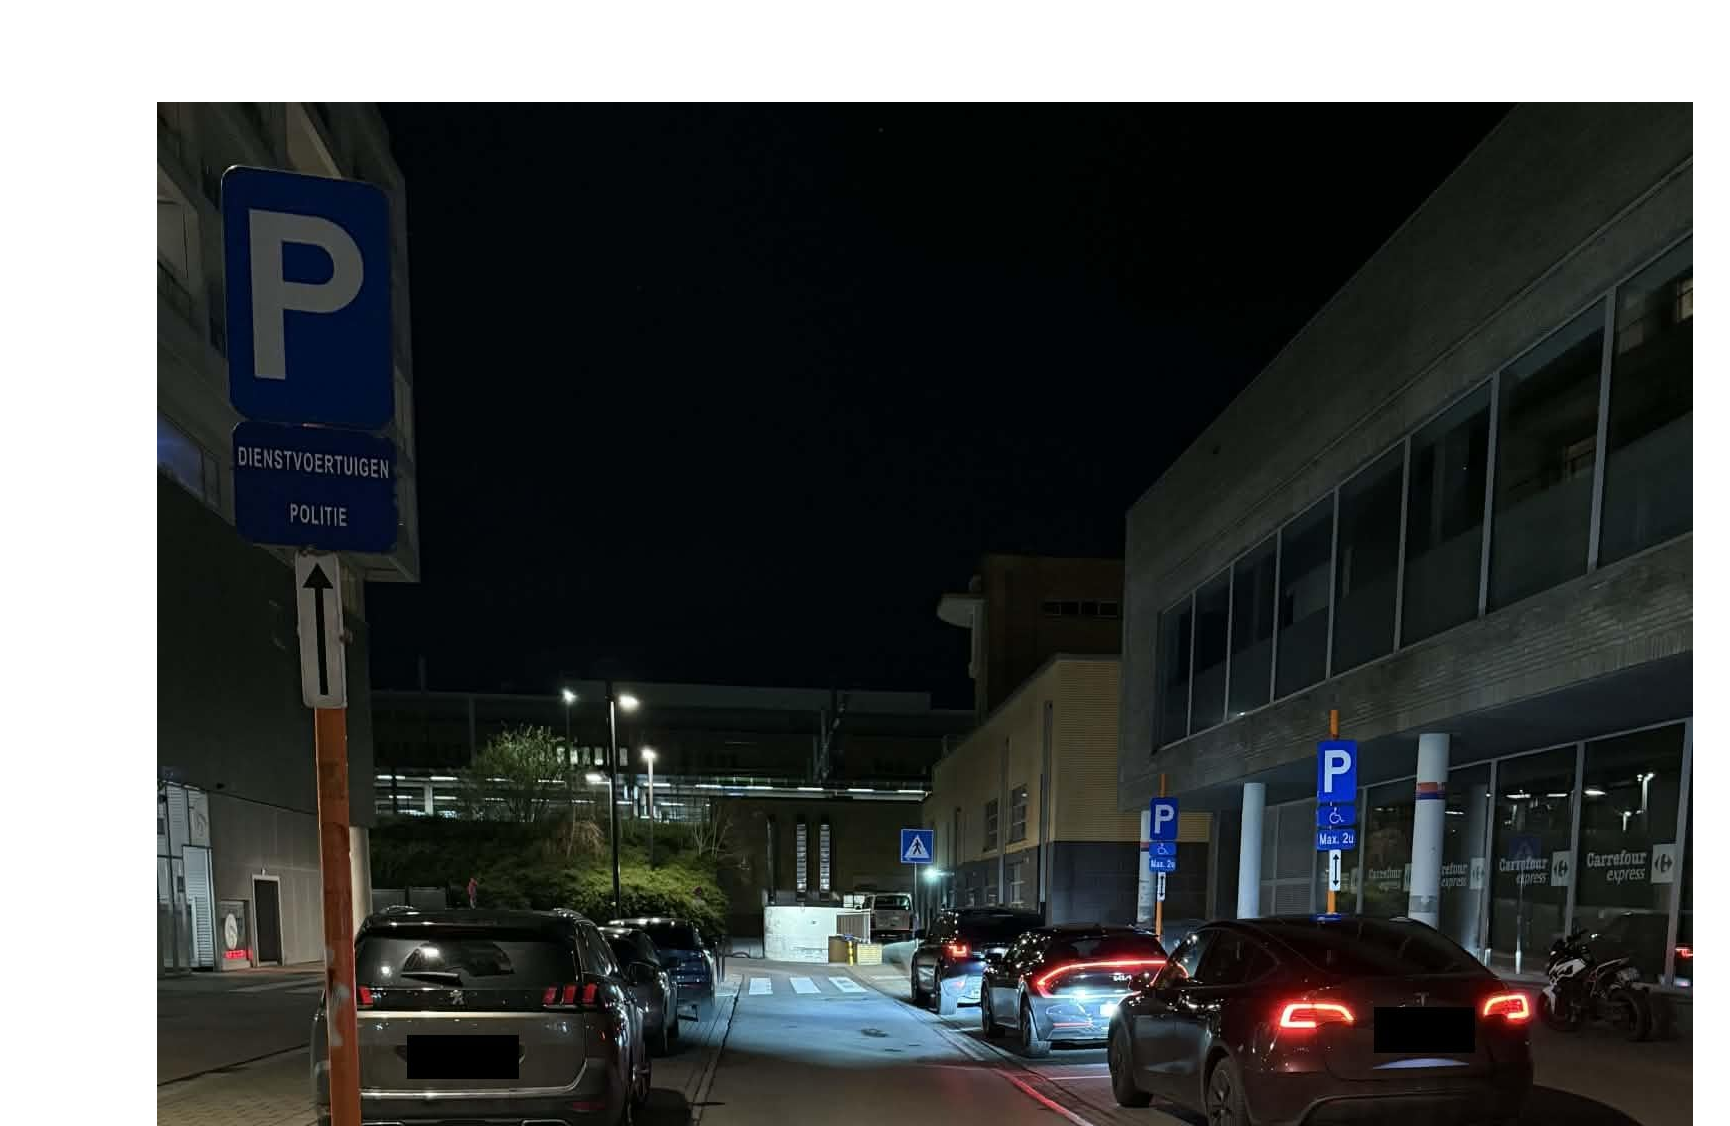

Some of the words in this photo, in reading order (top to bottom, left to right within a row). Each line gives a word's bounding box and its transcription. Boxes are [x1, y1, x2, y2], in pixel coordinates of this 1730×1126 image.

[248, 208, 364, 380] P
[238, 446, 390, 479] DIENSTVOERTUIGEN
[290, 503, 348, 527] POLITIE
[1324, 750, 1351, 793] P
[1154, 804, 1175, 834] P
[1320, 833, 1340, 846] Max.
[1342, 832, 1354, 845] 2u
[1587, 850, 1648, 867] Carrefour
[1606, 866, 1646, 885] express
